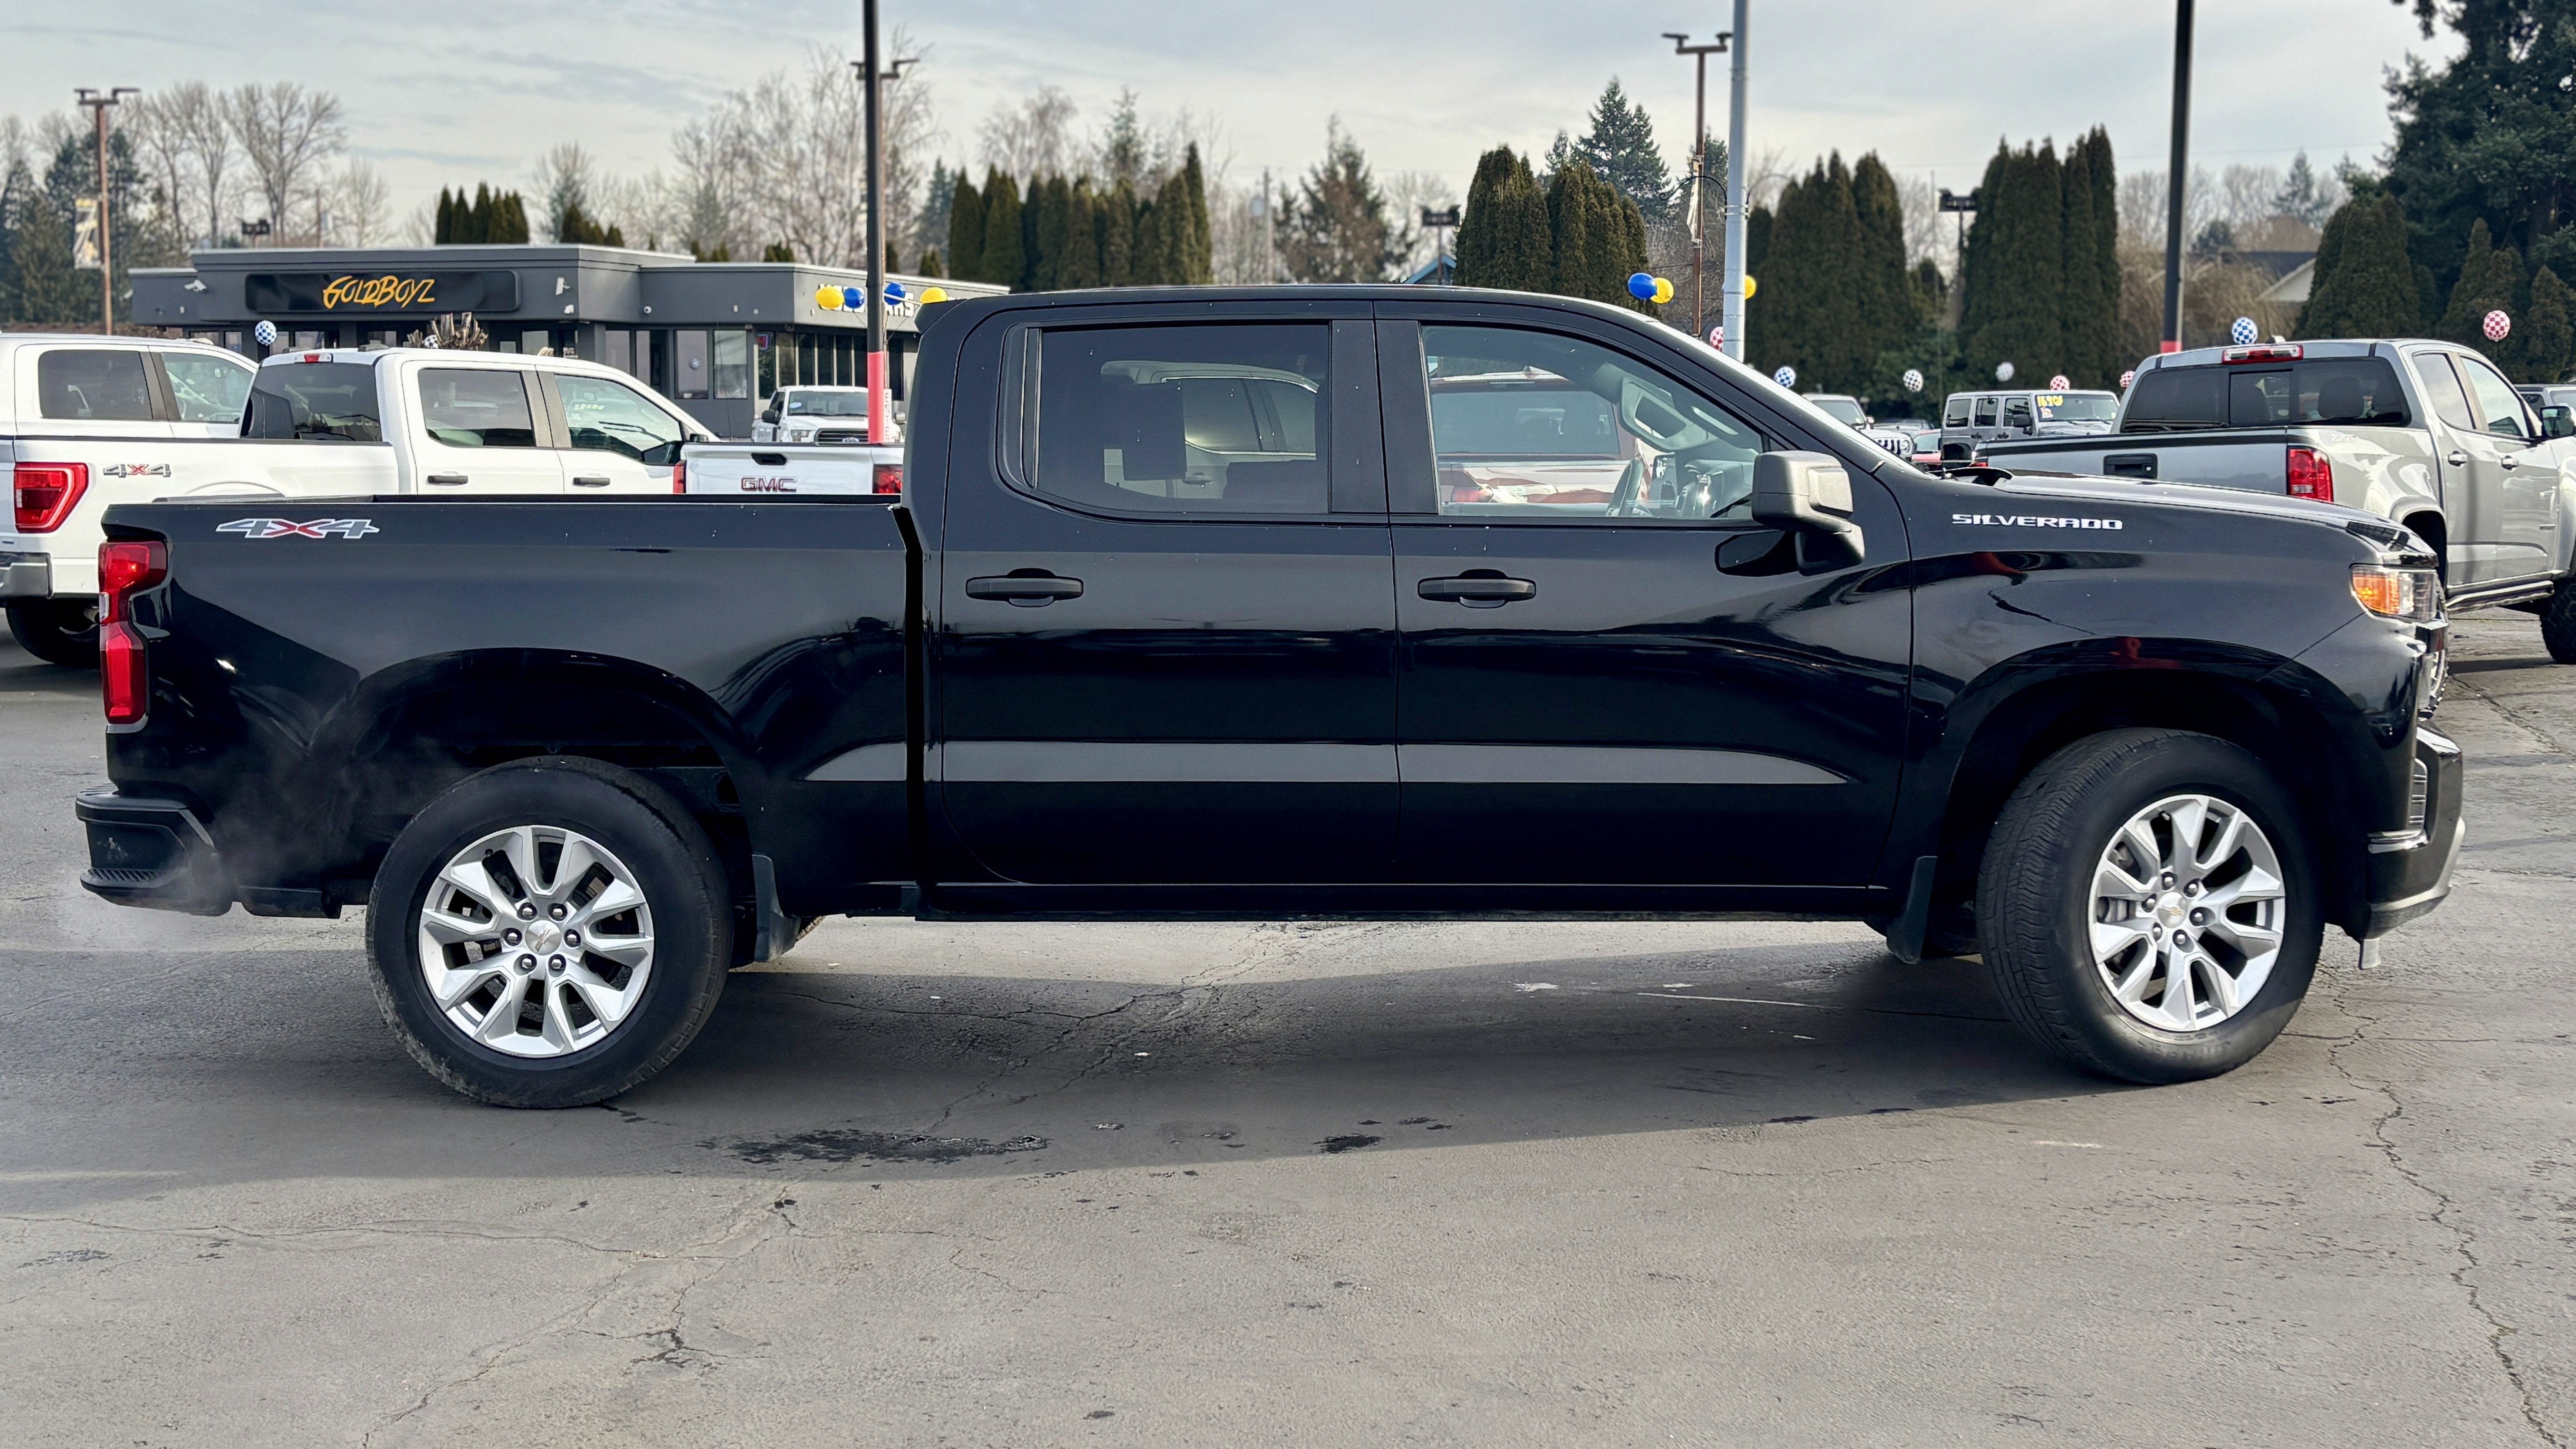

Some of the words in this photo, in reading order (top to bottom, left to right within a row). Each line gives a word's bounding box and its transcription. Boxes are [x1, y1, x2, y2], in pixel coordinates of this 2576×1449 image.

[323, 276, 435, 309] GOLDBOYZ
[741, 476, 797, 492] GMC
[1952, 514, 2123, 530] SILVERADO
